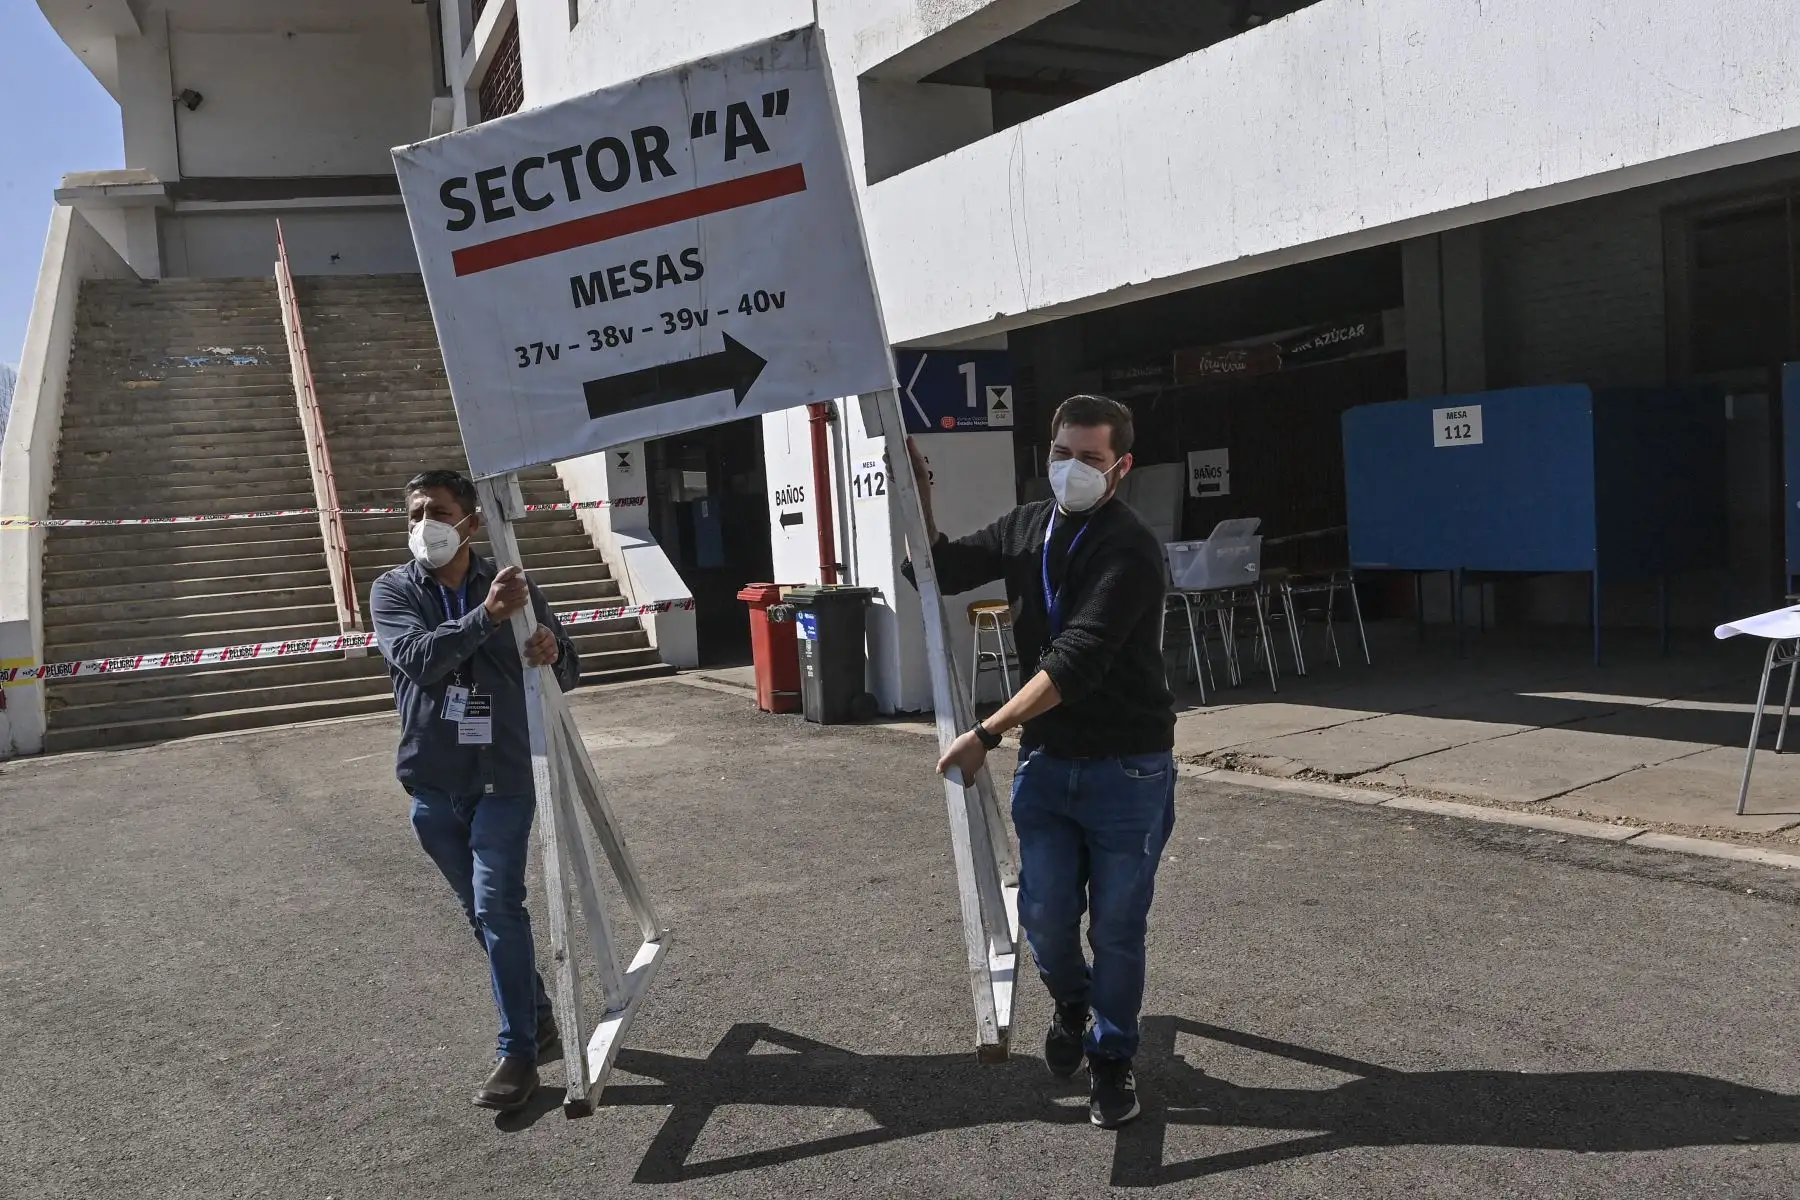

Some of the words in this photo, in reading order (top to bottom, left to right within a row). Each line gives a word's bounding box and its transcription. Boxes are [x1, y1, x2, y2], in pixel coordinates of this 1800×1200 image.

[439, 125, 677, 232] SECTOR
[570, 247, 705, 309] MESAS
[514, 342, 561, 368] 37v
[586, 325, 634, 352] 38v
[660, 306, 709, 335] 39v
[737, 288, 787, 317] 40v
[1314, 323, 1365, 348] AZÚCAR
[958, 361, 977, 408] 1
[1446, 411, 1468, 420] MESA
[1444, 424, 1471, 440] 112
[862, 461, 876, 469] MESA
[1193, 464, 1222, 480] BAÑOS
[775, 484, 805, 507] BAÑOS
[853, 471, 886, 498] 112
[45, 663, 73, 677] PELIGRO
[108, 658, 135, 671] PELIGRO
[169, 652, 195, 665] PELIGRO
[228, 647, 254, 659] PELIGRO
[286, 641, 311, 654] PELIGRO
[342, 636, 366, 647] PELIGRO
